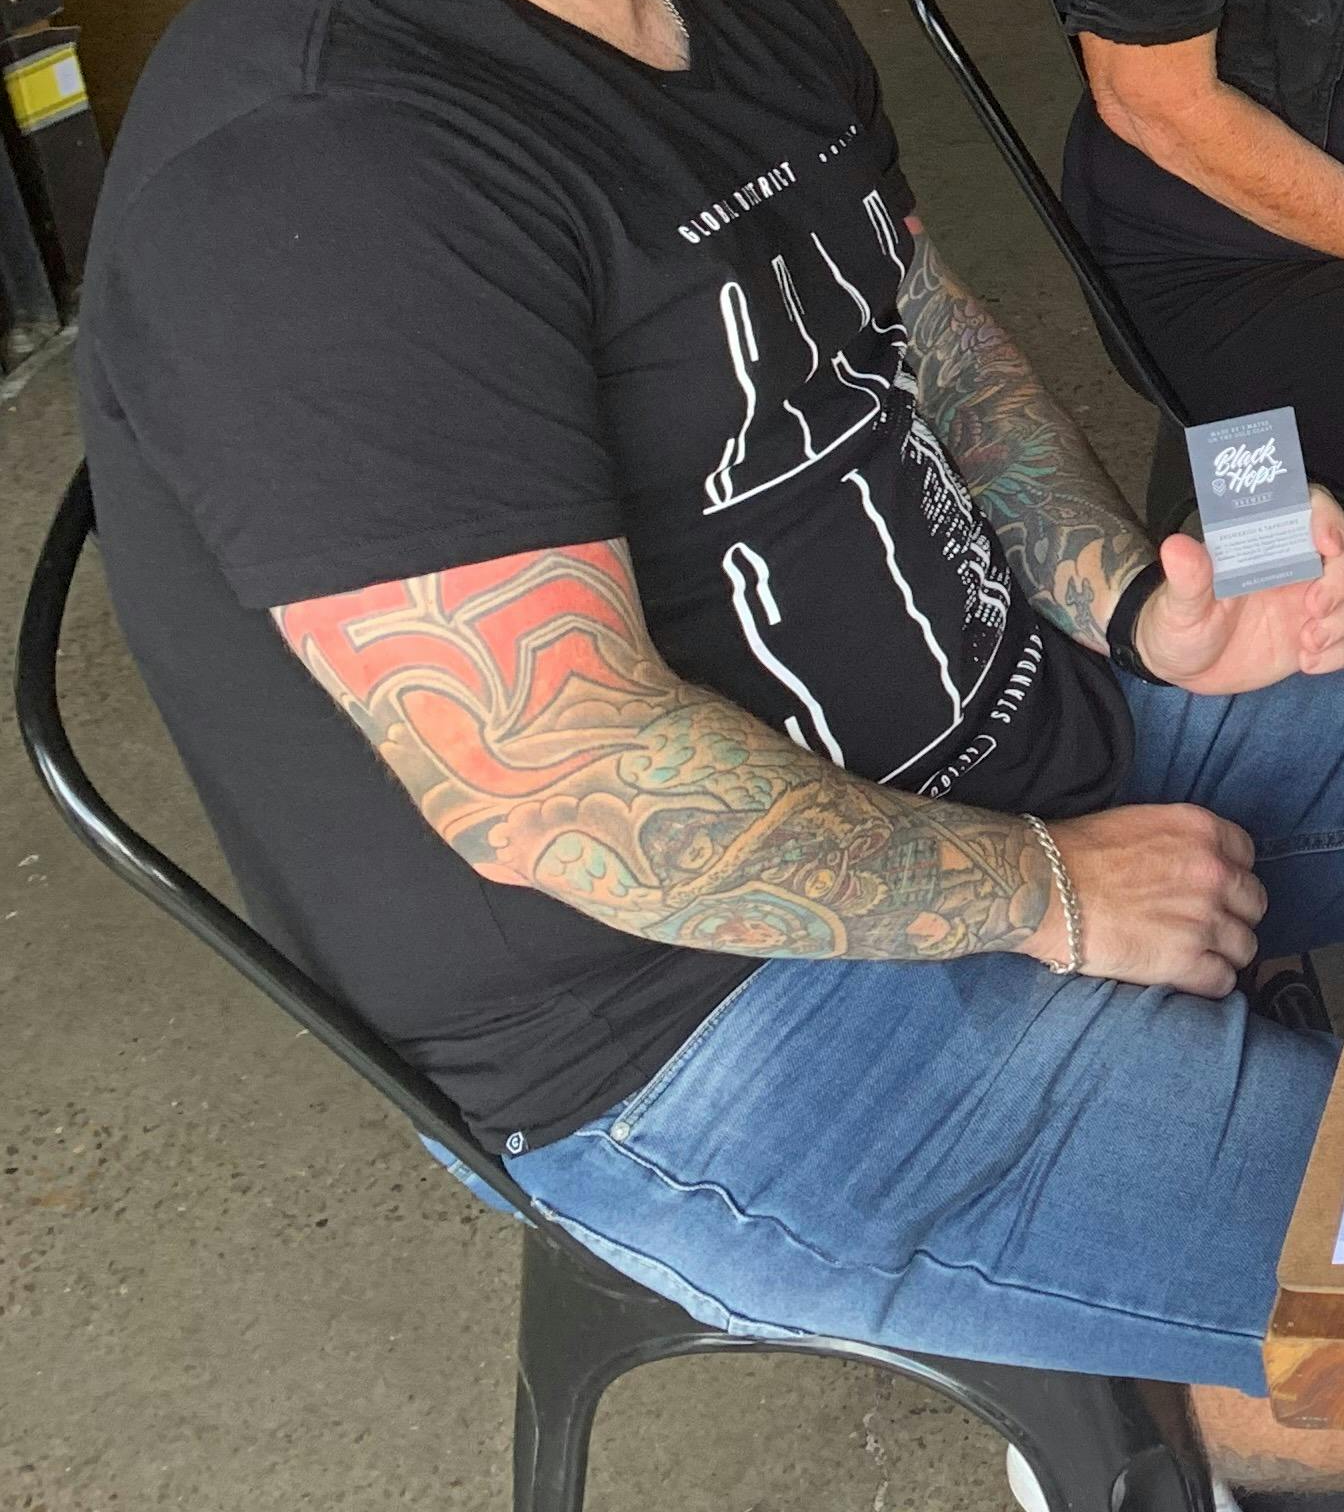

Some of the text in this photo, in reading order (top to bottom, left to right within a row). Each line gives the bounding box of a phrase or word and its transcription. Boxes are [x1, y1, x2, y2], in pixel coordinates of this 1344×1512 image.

[1214, 438, 1279, 476] Black
[1227, 461, 1287, 494] Hops
[990, 625, 1043, 723] STANDAR
